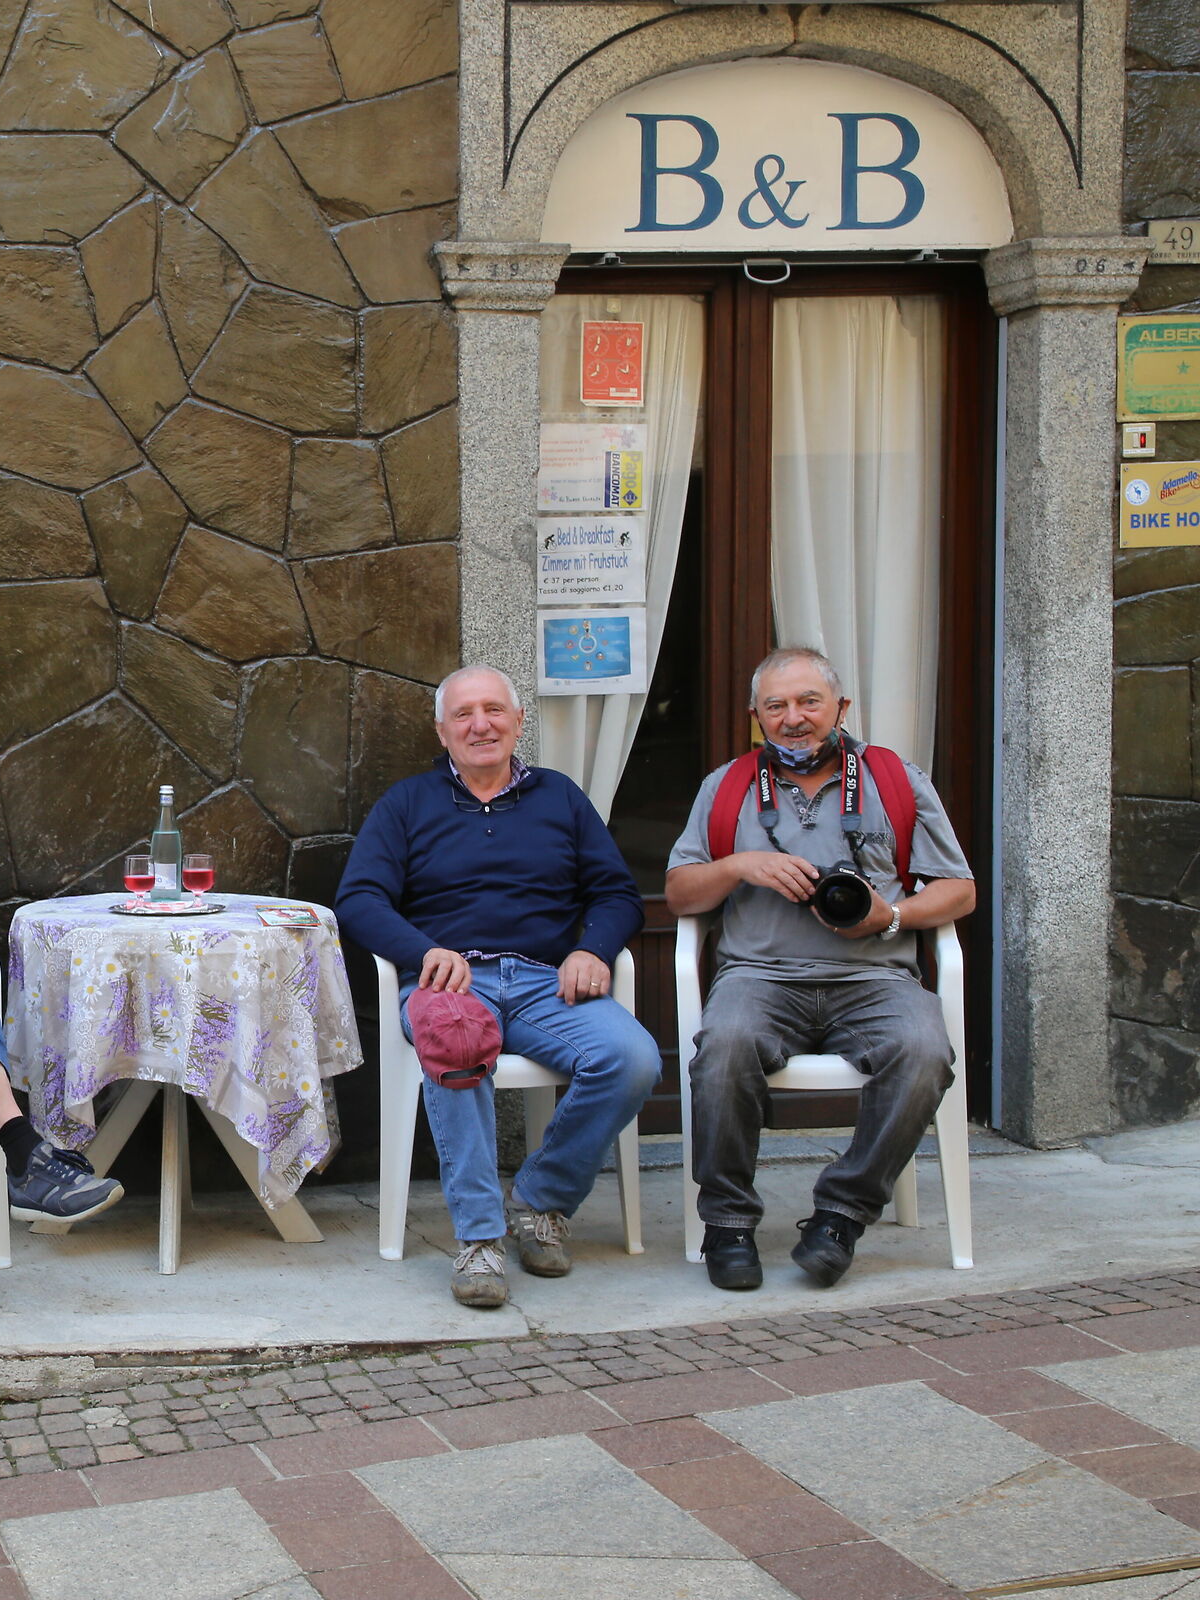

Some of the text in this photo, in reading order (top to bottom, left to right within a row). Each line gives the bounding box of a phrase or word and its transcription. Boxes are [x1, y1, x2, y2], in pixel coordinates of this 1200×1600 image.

[625, 112, 926, 233] B&B
[1163, 226, 1193, 250] 49
[1140, 328, 1200, 342] ALBER
[611, 453, 620, 507] BANCOMAT
[1163, 471, 1198, 490] Adamello
[1160, 488, 1177, 499] Bike
[1130, 512, 1200, 529] BIKE HO
[557, 527, 571, 546] Bed
[580, 525, 615, 545] Breakfast
[542, 552, 628, 572] Zimmer mit Fruhstuck
[563, 577, 574, 585] per
[577, 576, 599, 584] person
[570, 586, 600, 594] soggiorno
[847, 753, 857, 776] EOS
[760, 768, 770, 802] Canon
[846, 777, 857, 790] 5D
